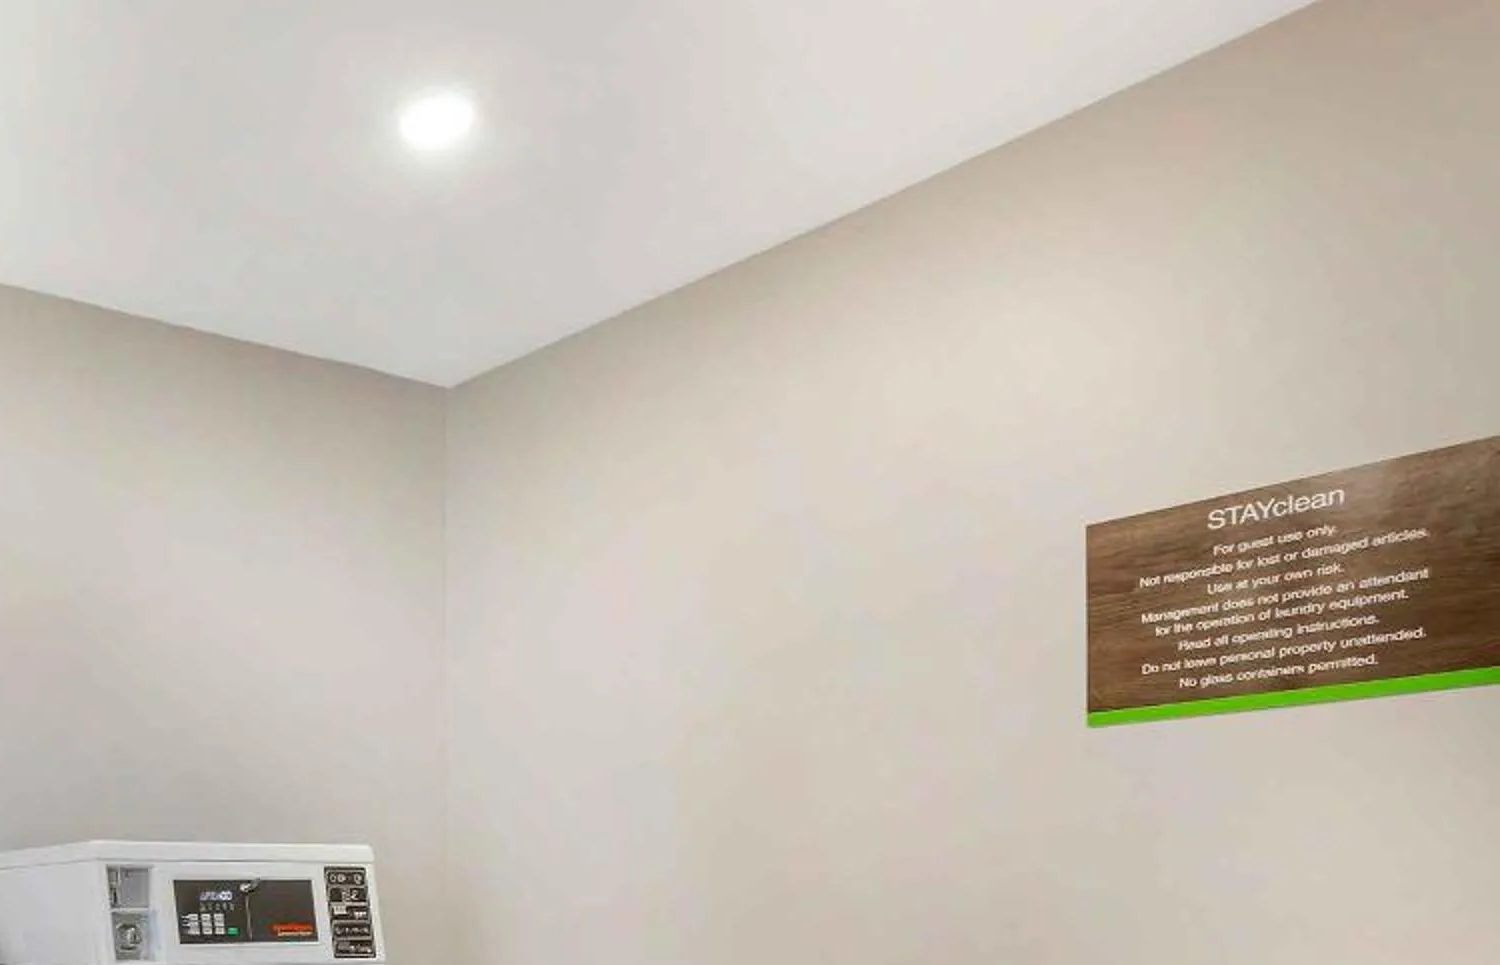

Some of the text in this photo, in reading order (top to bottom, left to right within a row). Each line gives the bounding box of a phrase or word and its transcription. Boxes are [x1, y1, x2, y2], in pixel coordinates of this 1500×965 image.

[1207, 489, 1345, 530] STAYclean
[1140, 575, 1160, 588] Not
[1164, 563, 1233, 583] responsible
[1236, 559, 1254, 571] for
[1257, 554, 1281, 567] lost
[1283, 552, 1298, 562] or
[1302, 537, 1369, 559] damaged
[1213, 544, 1234, 556] For
[1238, 536, 1274, 553] guest
[1278, 531, 1302, 543] use
[1141, 568, 1429, 624] Management does not provide an attendant
[1207, 562, 1345, 595] Use at your own risk.
[1155, 589, 1409, 636] for the operation of laundry equipment.
[1178, 614, 1380, 651] Read all operating instructions.
[1141, 627, 1427, 675] Do not leave personal property unattended.
[1179, 653, 1379, 688] No glass containers permitted.
